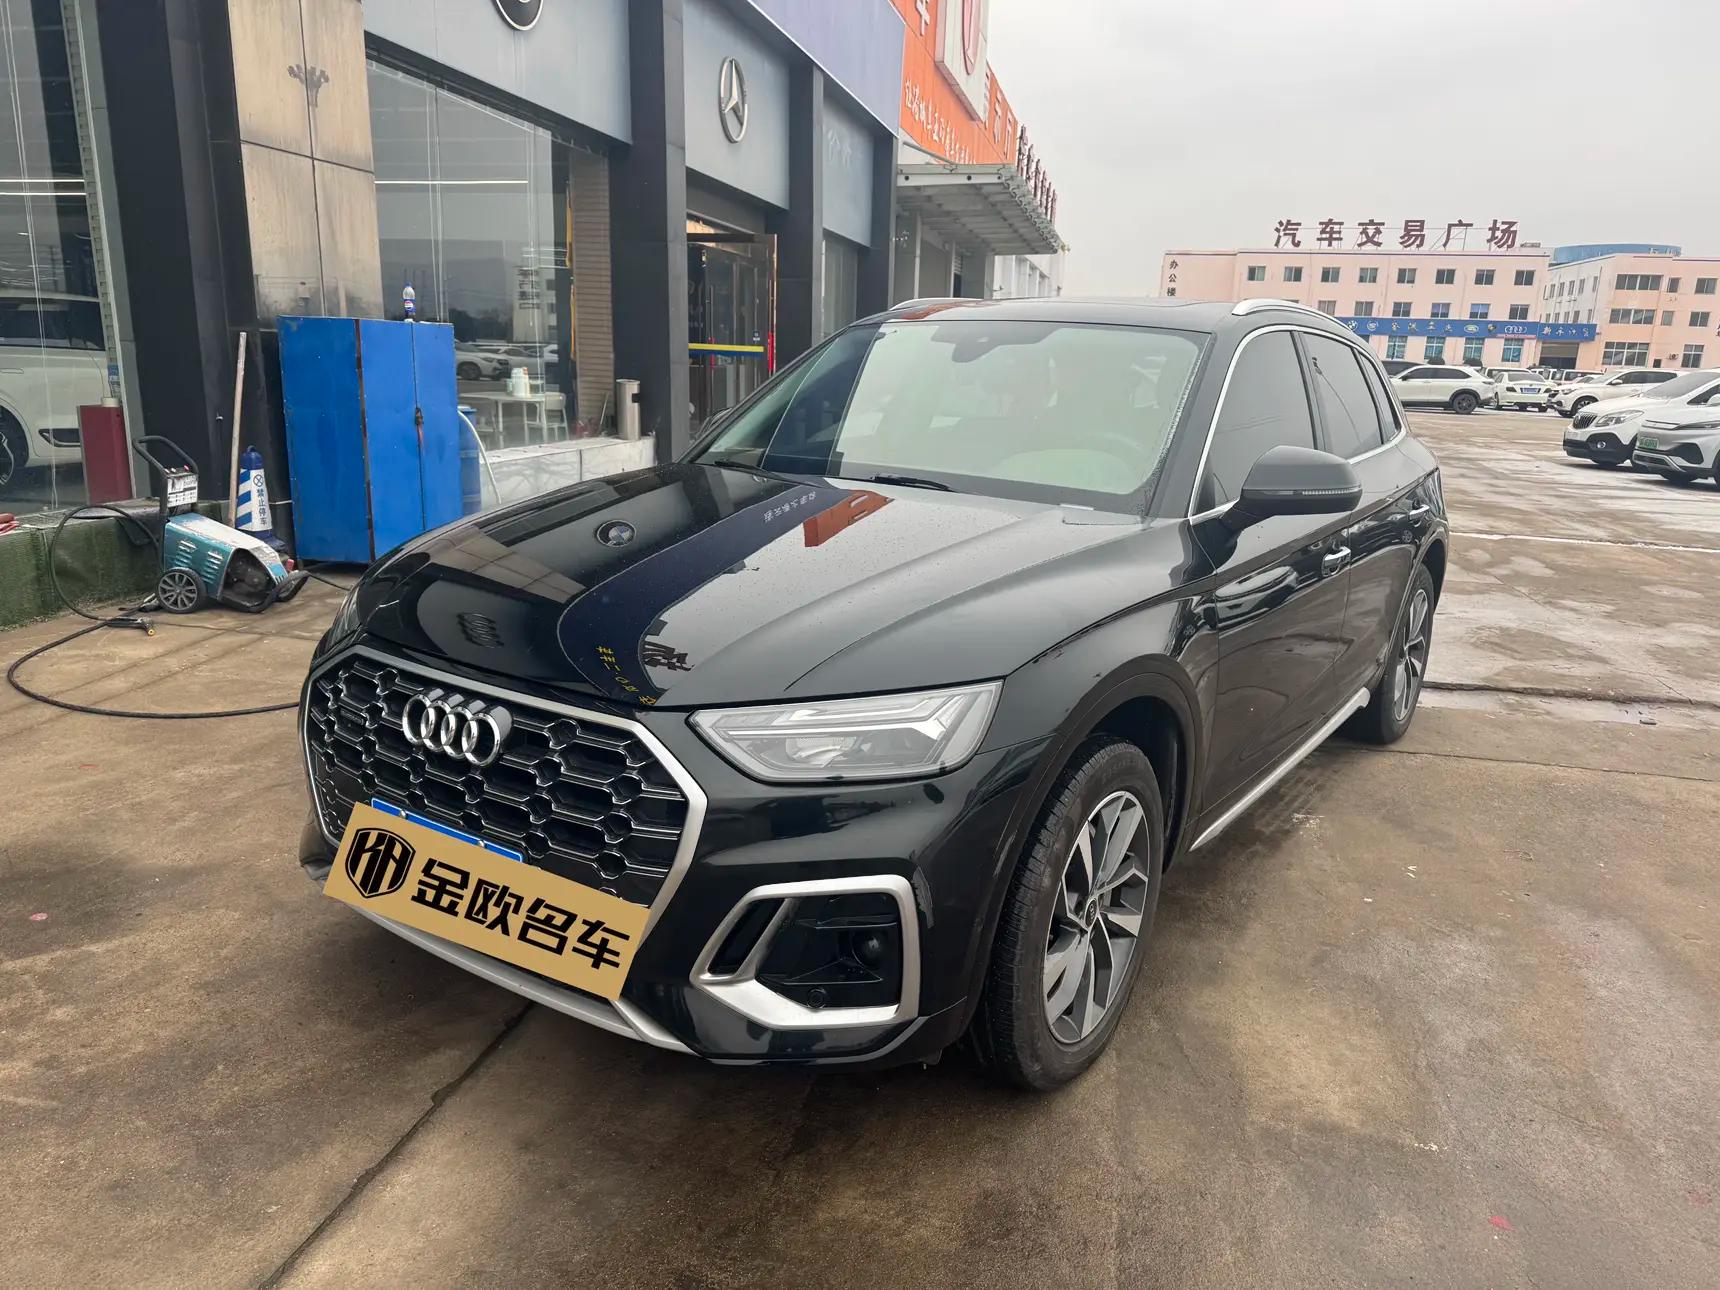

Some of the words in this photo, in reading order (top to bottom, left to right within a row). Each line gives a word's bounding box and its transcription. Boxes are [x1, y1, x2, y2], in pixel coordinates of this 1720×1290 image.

[1274, 218, 1518, 249] 汽车交易广场
[1167, 259, 1178, 297] 办公楼
[257, 488, 267, 526] 禁止停车
